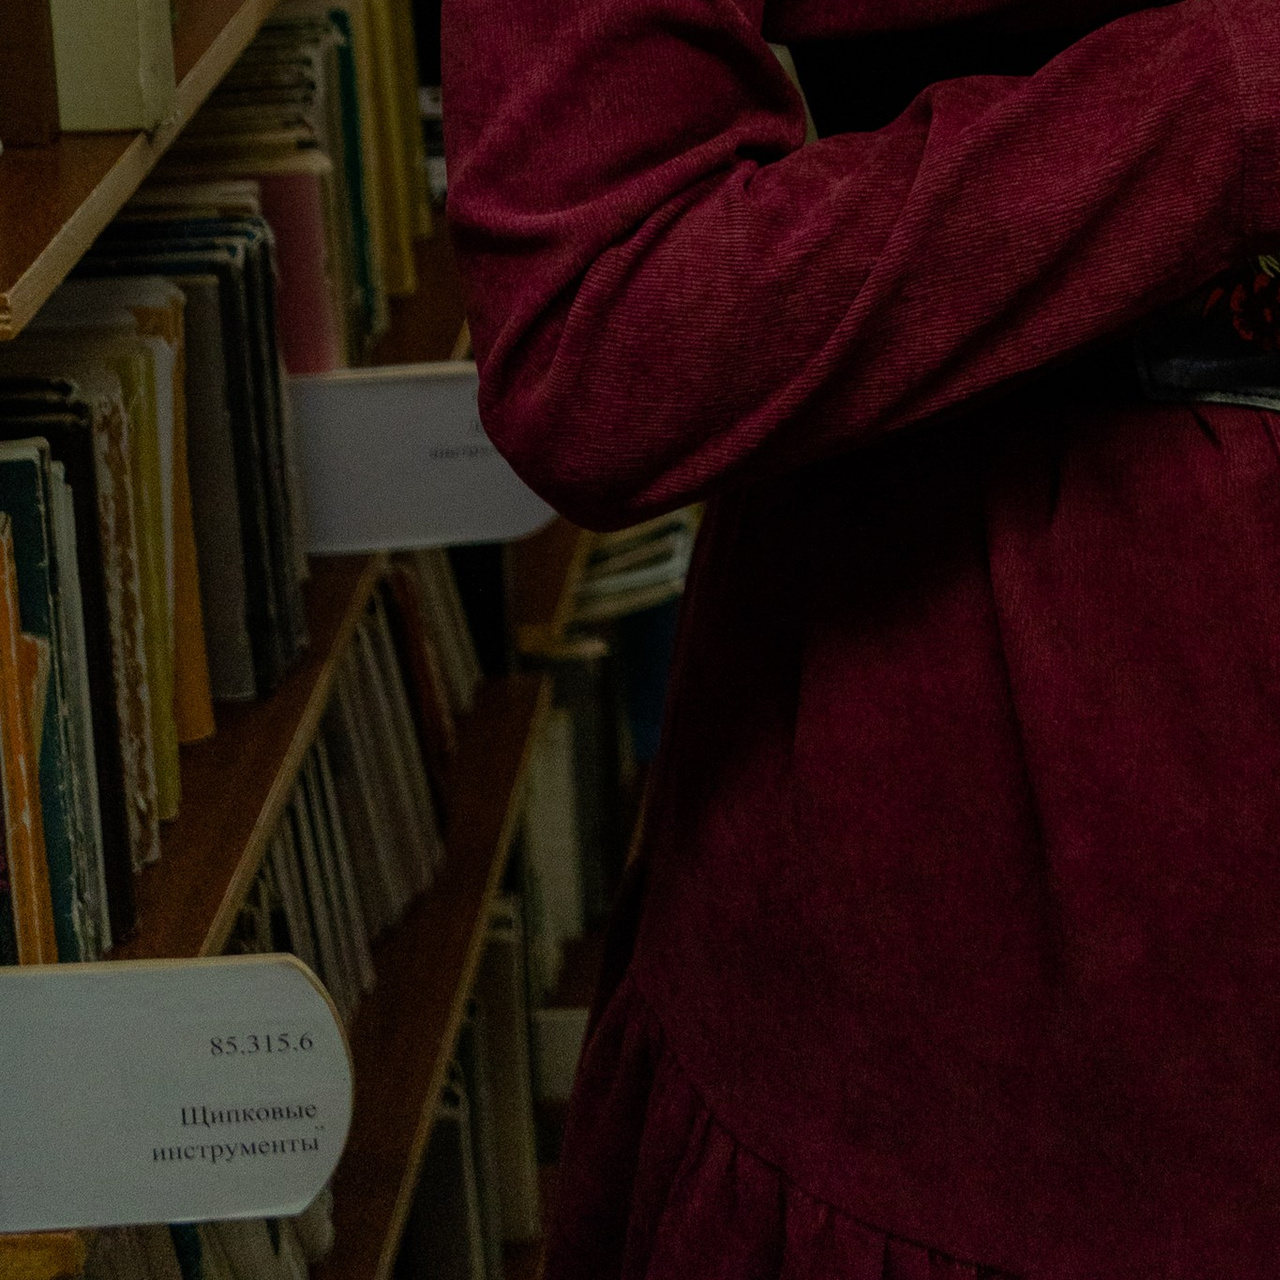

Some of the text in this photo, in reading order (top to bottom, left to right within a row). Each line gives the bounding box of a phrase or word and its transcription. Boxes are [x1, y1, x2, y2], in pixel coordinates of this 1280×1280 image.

[210, 1031, 313, 1056] 85.315.6
[180, 1104, 318, 1129] Щипковые
[152, 1138, 320, 1163] инструменты
